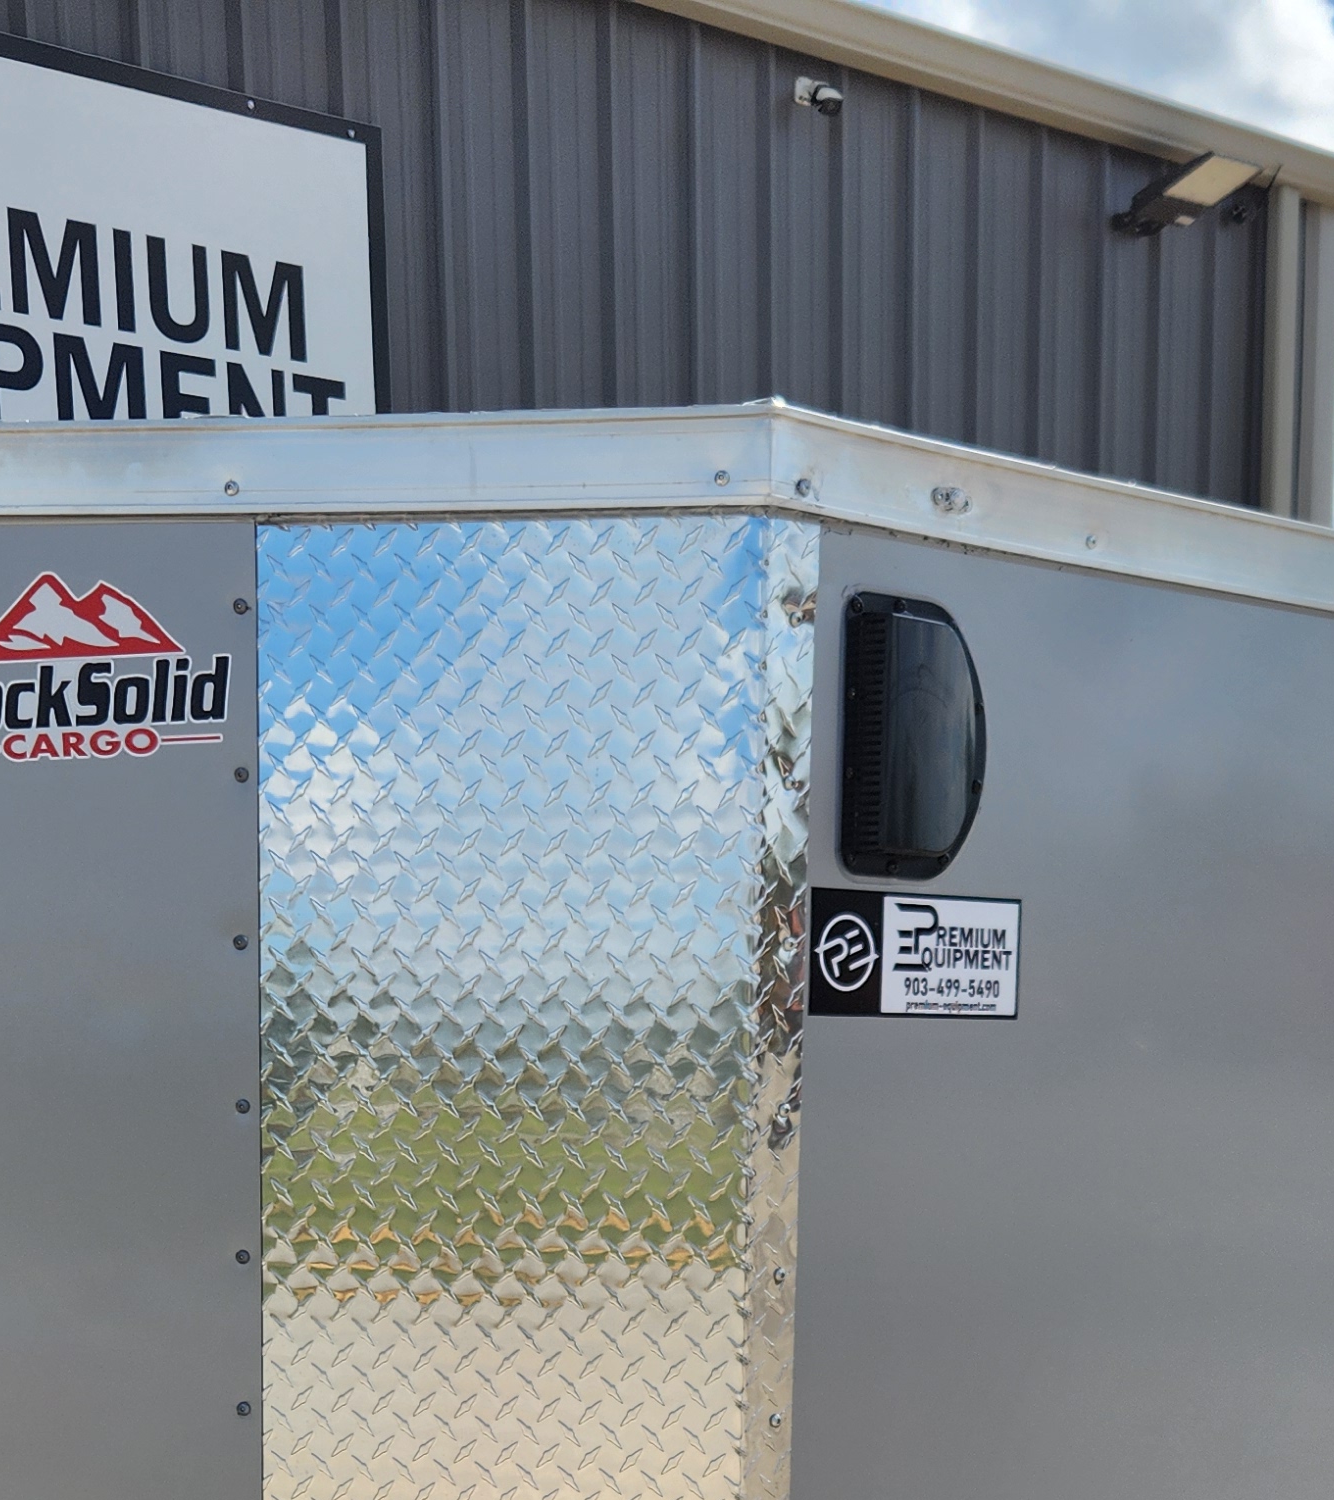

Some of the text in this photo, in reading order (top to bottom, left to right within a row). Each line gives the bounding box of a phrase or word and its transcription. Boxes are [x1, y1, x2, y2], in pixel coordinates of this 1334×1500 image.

[2, 728, 158, 760] CARGO
[894, 902, 1007, 955] PREMIUM
[892, 930, 1013, 972] EQUIPMENT
[904, 977, 1000, 998] 903-499-5490
[905, 1000, 997, 1012] premium-equipment.com
